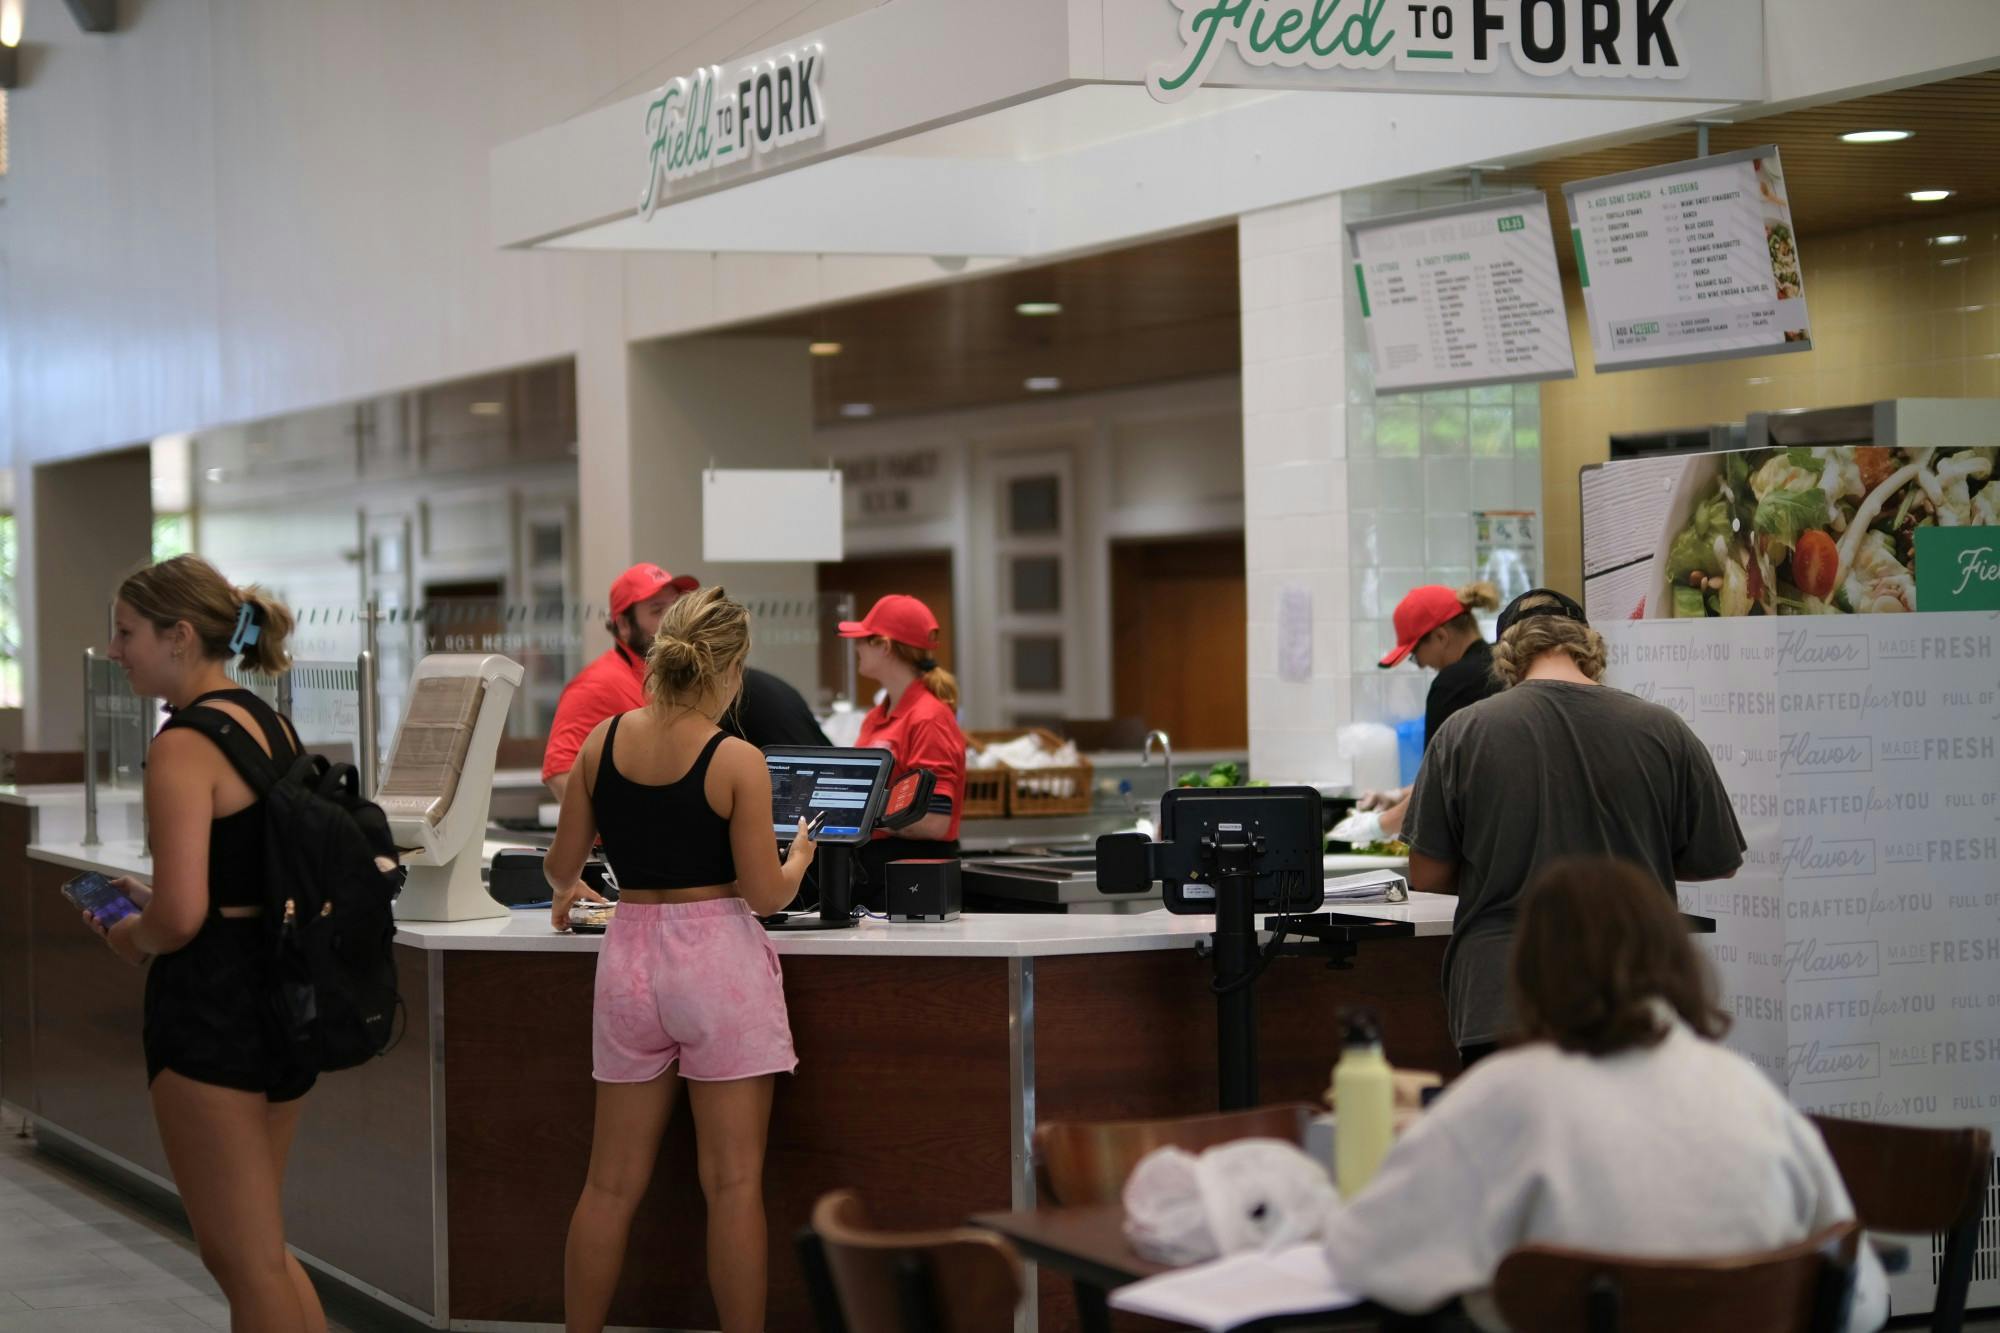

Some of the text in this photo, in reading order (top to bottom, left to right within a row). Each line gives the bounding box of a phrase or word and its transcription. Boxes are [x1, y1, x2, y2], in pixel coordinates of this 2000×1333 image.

[1158, 0, 1679, 90] Field TO FORK
[641, 56, 816, 211] Field TO FORK
[1952, 546, 2000, 594] Fie
[1636, 645, 1689, 662] CRAFTED
[1706, 644, 1730, 661] YOU
[1740, 629, 1861, 676] FULL OF Flavor
[1879, 635, 1991, 660] MADE FRESH
[1700, 693, 1726, 707] MADE
[1728, 692, 1775, 715] FRESH
[1779, 692, 1860, 712] CRAFTED
[1891, 690, 1926, 708] YOU
[1943, 691, 1995, 706] FULL OF
[1710, 743, 1733, 761] YOU
[1775, 731, 1863, 778] Flavor
[1881, 735, 1994, 760] MADE FRESH
[1732, 793, 1778, 817] FRESH
[1783, 796, 1863, 816] CRAFTED
[1895, 792, 1929, 810] YOU
[1945, 794, 1976, 808] FULL
[1769, 853, 1780, 865] OF
[1777, 835, 1865, 881] Flavor
[1886, 837, 1997, 862] MADE FRESH
[1733, 893, 1780, 920] FRESH
[1787, 897, 1866, 919] CRAFTED
[1898, 893, 1932, 912] YOU
[1949, 895, 1979, 910] FULL
[1714, 944, 1737, 962] YOU
[1748, 938, 1868, 984] FULL OF Flavor
[1888, 938, 2000, 964] MADE FRESH
[1736, 995, 1783, 1022] FRESH
[1791, 1000, 1869, 1021] CRAFTED
[1901, 994, 1935, 1013] YOU
[1951, 996, 1982, 1008] FULL
[1784, 1040, 1870, 1087] Flavor
[1889, 1038, 2000, 1064] MADE FRESH
[1807, 1101, 1871, 1119] RAFTED
[1902, 1096, 1936, 1115] YOU
[1953, 1096, 1984, 1110] FULL
